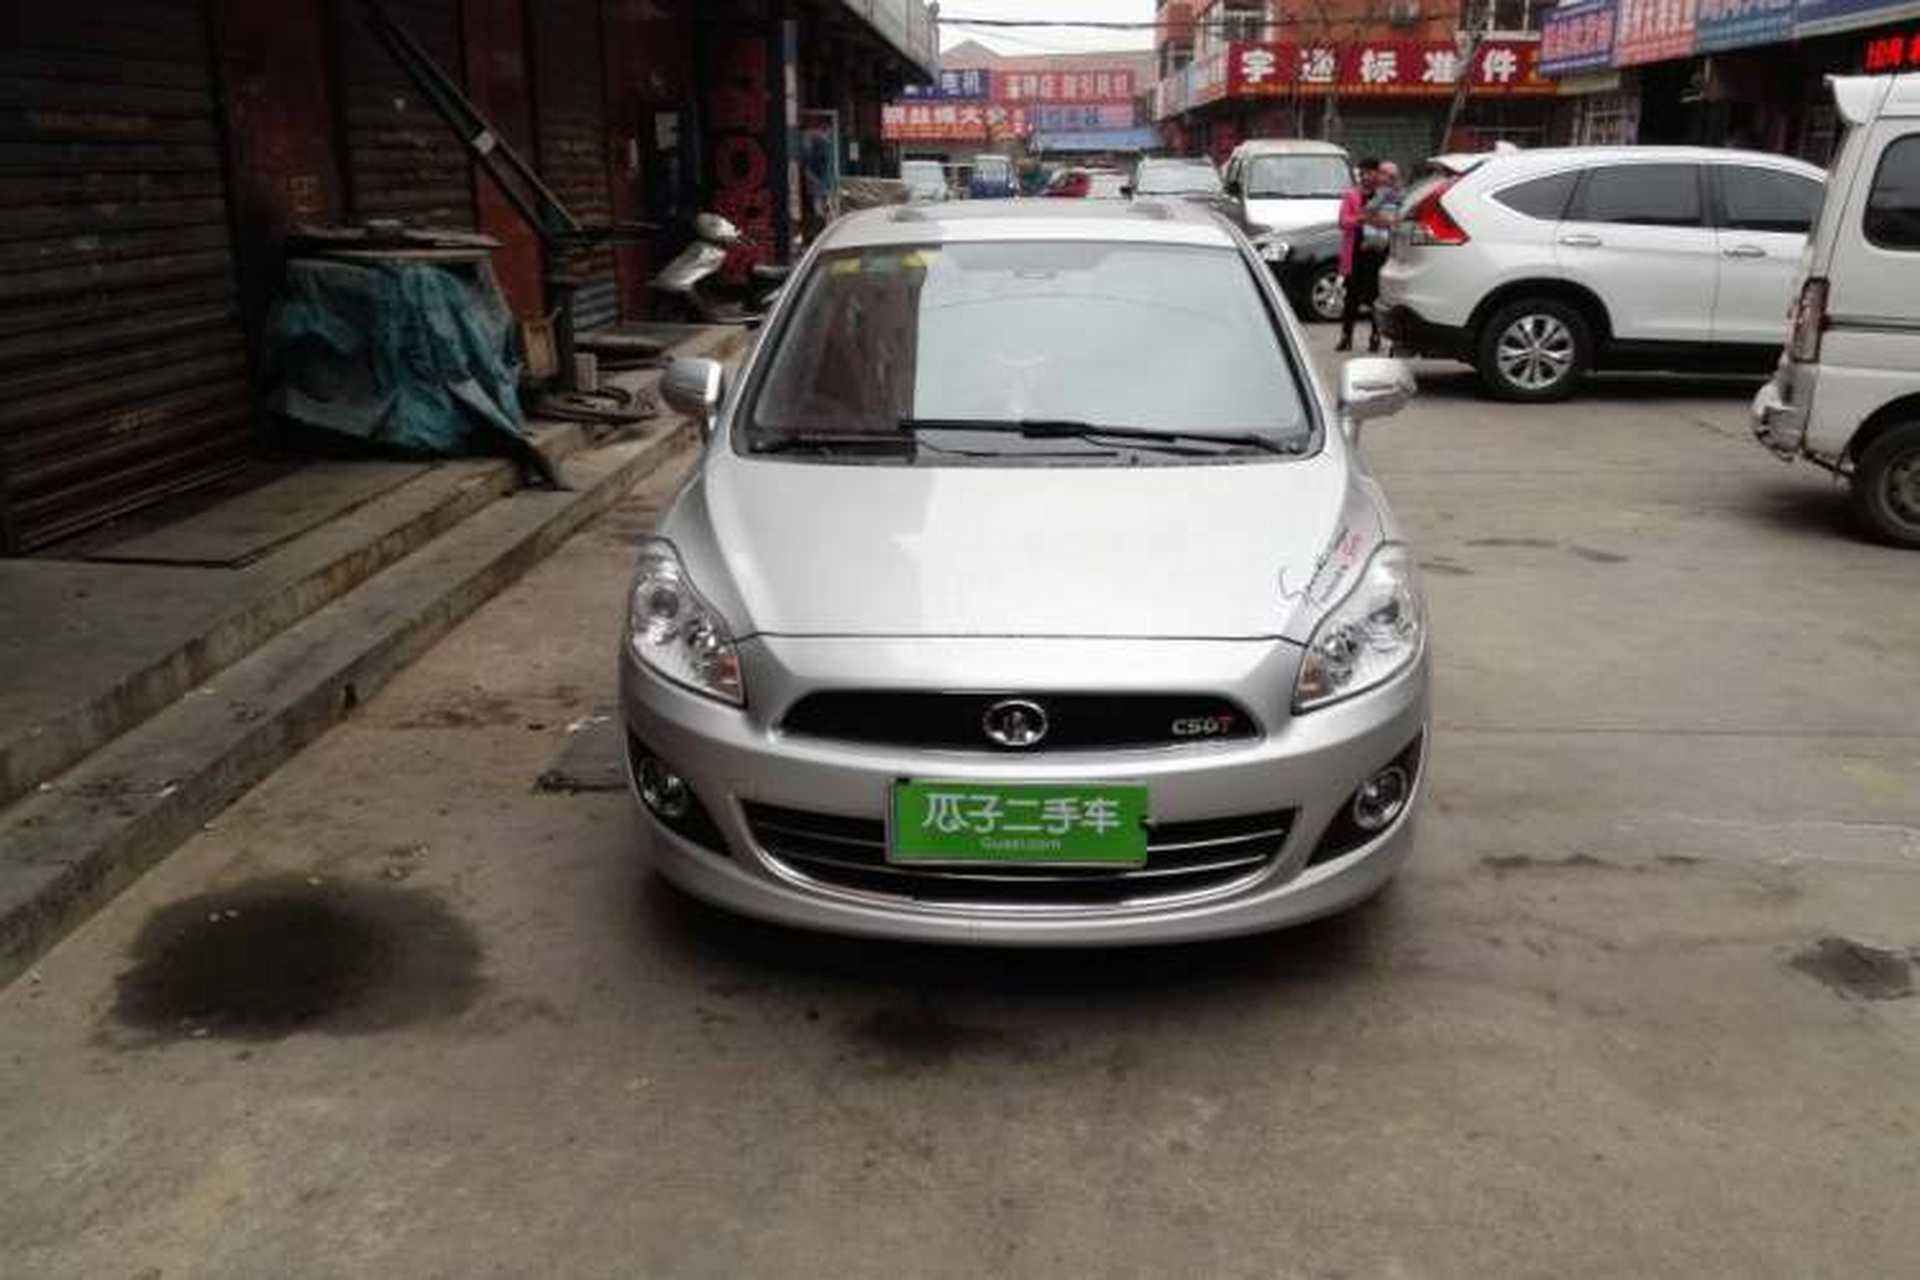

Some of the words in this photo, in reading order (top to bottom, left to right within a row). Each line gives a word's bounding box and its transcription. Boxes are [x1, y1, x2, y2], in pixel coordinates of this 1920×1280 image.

[921, 793, 1121, 834] 瓜子二手车
